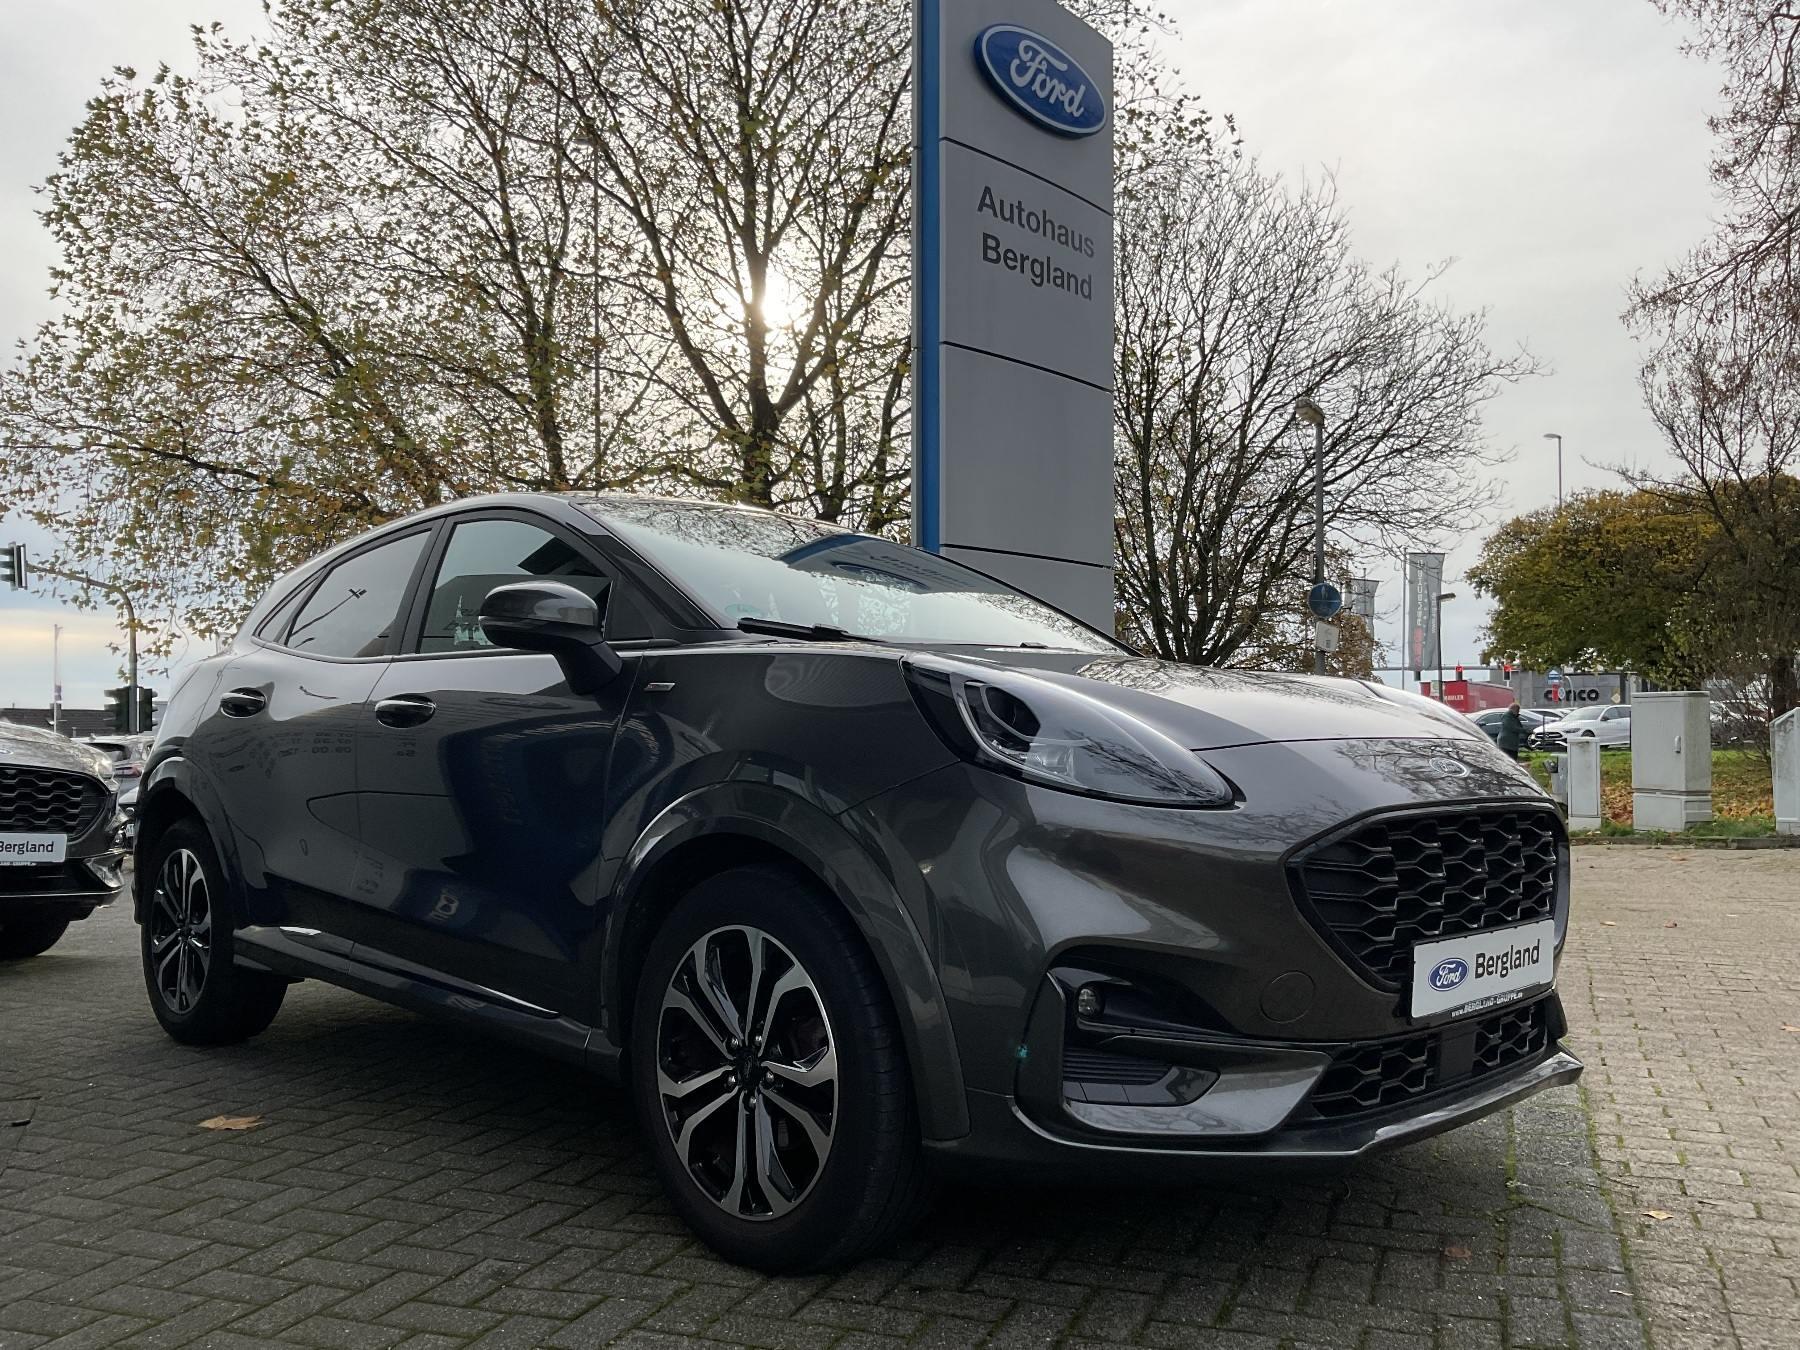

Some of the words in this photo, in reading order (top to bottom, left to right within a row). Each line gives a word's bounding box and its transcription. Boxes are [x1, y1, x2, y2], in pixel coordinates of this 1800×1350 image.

[1010, 40, 1084, 117] Ford
[977, 186, 1095, 258] Autohaus
[982, 232, 1092, 301] Bergland
[1436, 963, 1461, 987] Ford
[1475, 939, 1540, 978] Bergland
